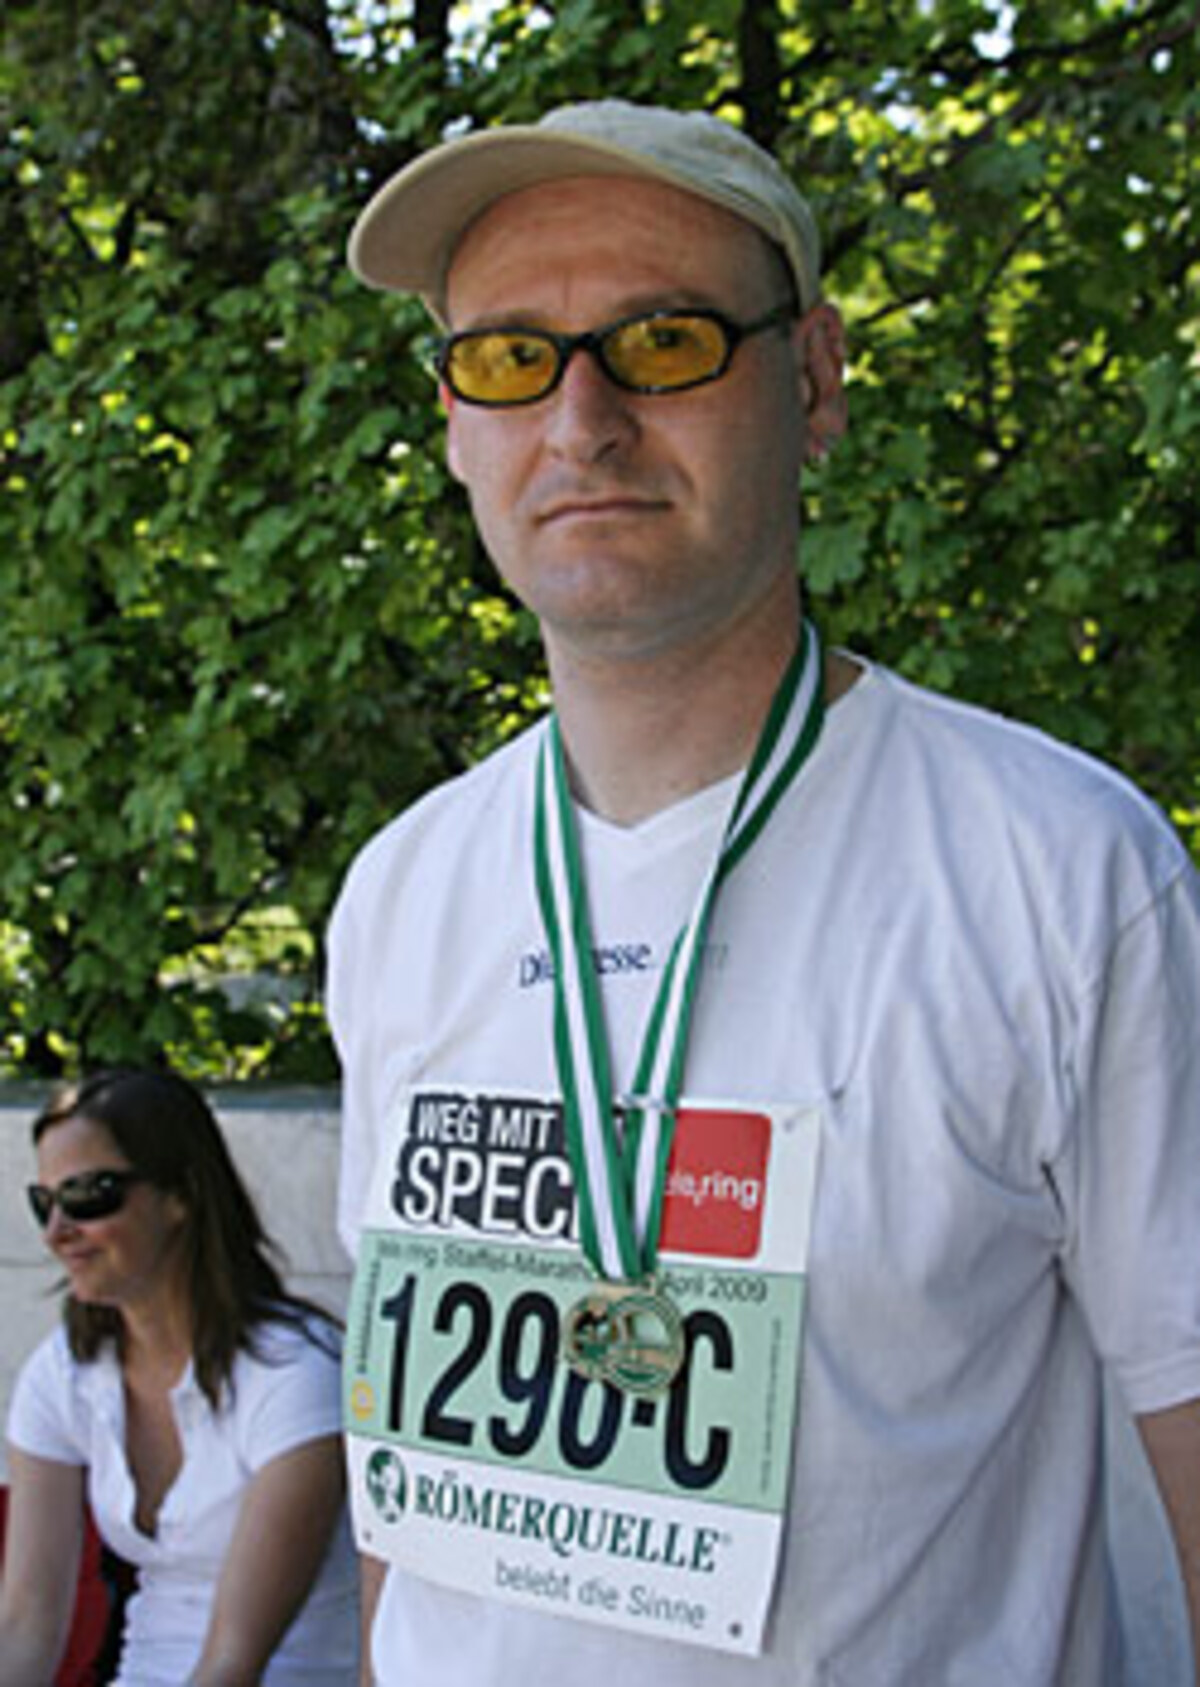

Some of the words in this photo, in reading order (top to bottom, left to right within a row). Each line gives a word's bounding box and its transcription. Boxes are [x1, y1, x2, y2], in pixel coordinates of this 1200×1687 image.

[592, 943, 651, 975] esse
[418, 1101, 480, 1144] WEG
[489, 1107, 558, 1150] MIT
[403, 1146, 580, 1240] SPEC
[708, 1277, 768, 1304] 2009
[414, 1469, 720, 1573] RÖMERQUELLE
[496, 1557, 570, 1602] belebt
[577, 1577, 619, 1611] die
[626, 1584, 706, 1630] Sinne
